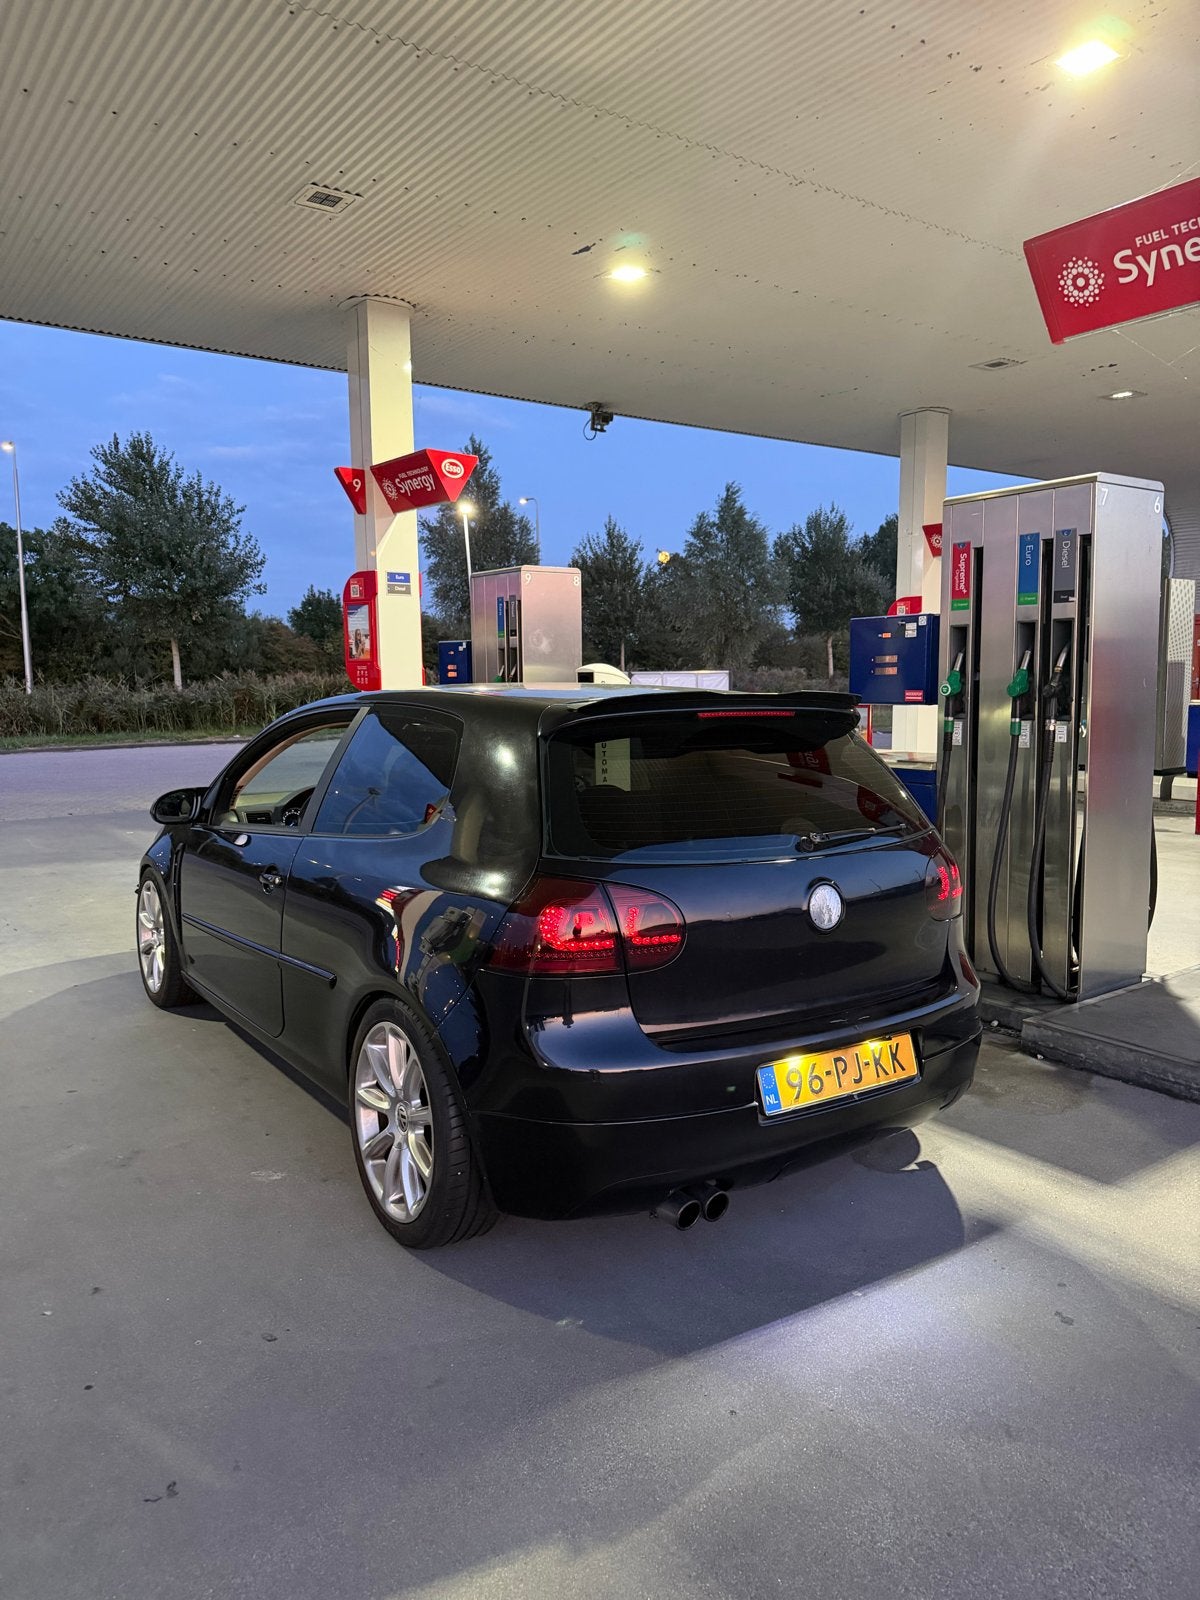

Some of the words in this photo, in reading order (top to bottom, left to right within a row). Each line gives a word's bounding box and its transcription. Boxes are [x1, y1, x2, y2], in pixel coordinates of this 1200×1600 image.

[1135, 229, 1169, 248] FUEL
[445, 463, 461, 474] Esso
[352, 478, 361, 492] 9
[395, 473, 435, 496] Synergy
[1101, 488, 1109, 506] 7
[1154, 496, 1161, 514] 6
[1024, 545, 1034, 566] Euro
[1061, 540, 1071, 569] Diesel
[525, 573, 532, 584] 9
[573, 575, 580, 586] 8
[766, 1094, 778, 1106] NL
[786, 1042, 906, 1100] 96-PJ-KK
